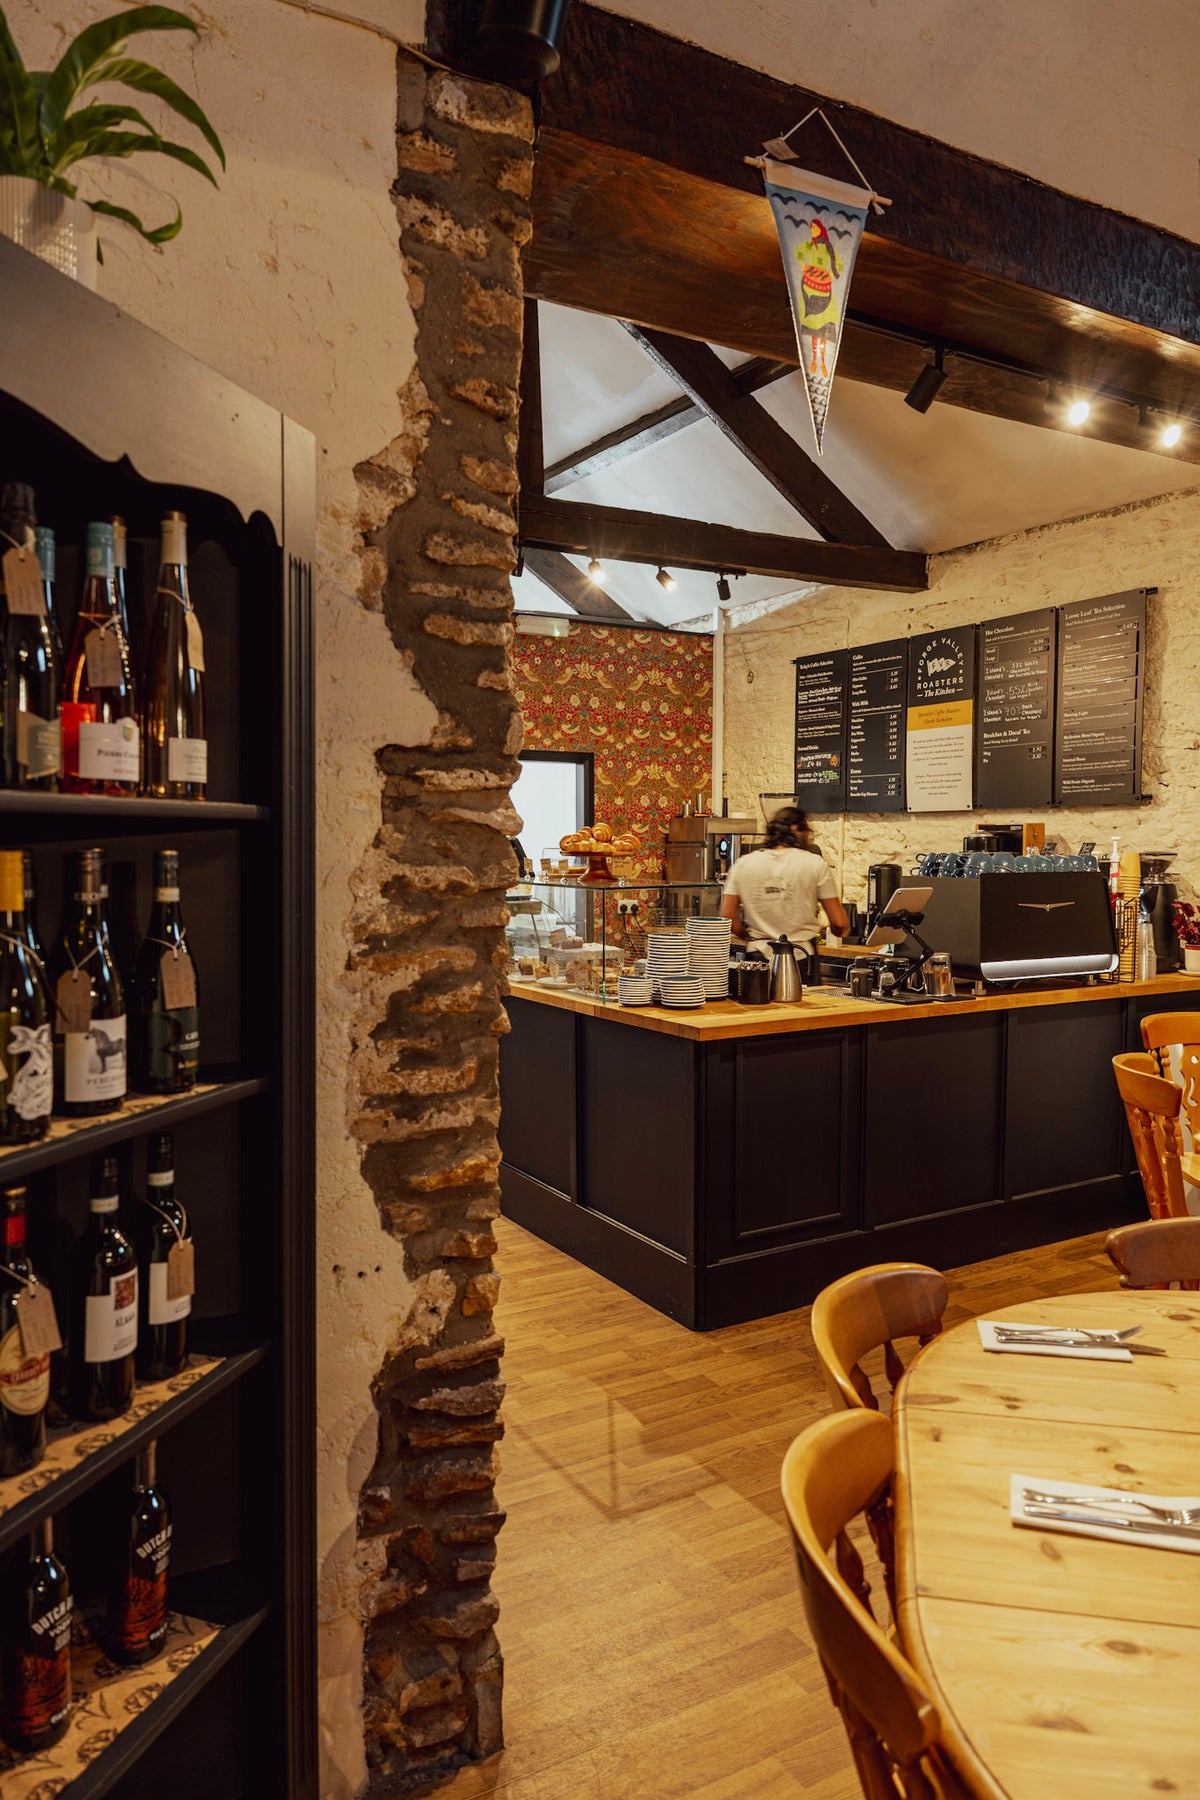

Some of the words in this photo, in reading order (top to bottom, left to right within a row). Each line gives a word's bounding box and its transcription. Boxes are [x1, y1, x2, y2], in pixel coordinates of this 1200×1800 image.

[1102, 603, 1126, 612] Selection
[917, 640, 937, 673] FORGE
[941, 637, 964, 666] VALLEY
[917, 676, 964, 690] ROASTERS
[935, 687, 955, 696] Kitchen
